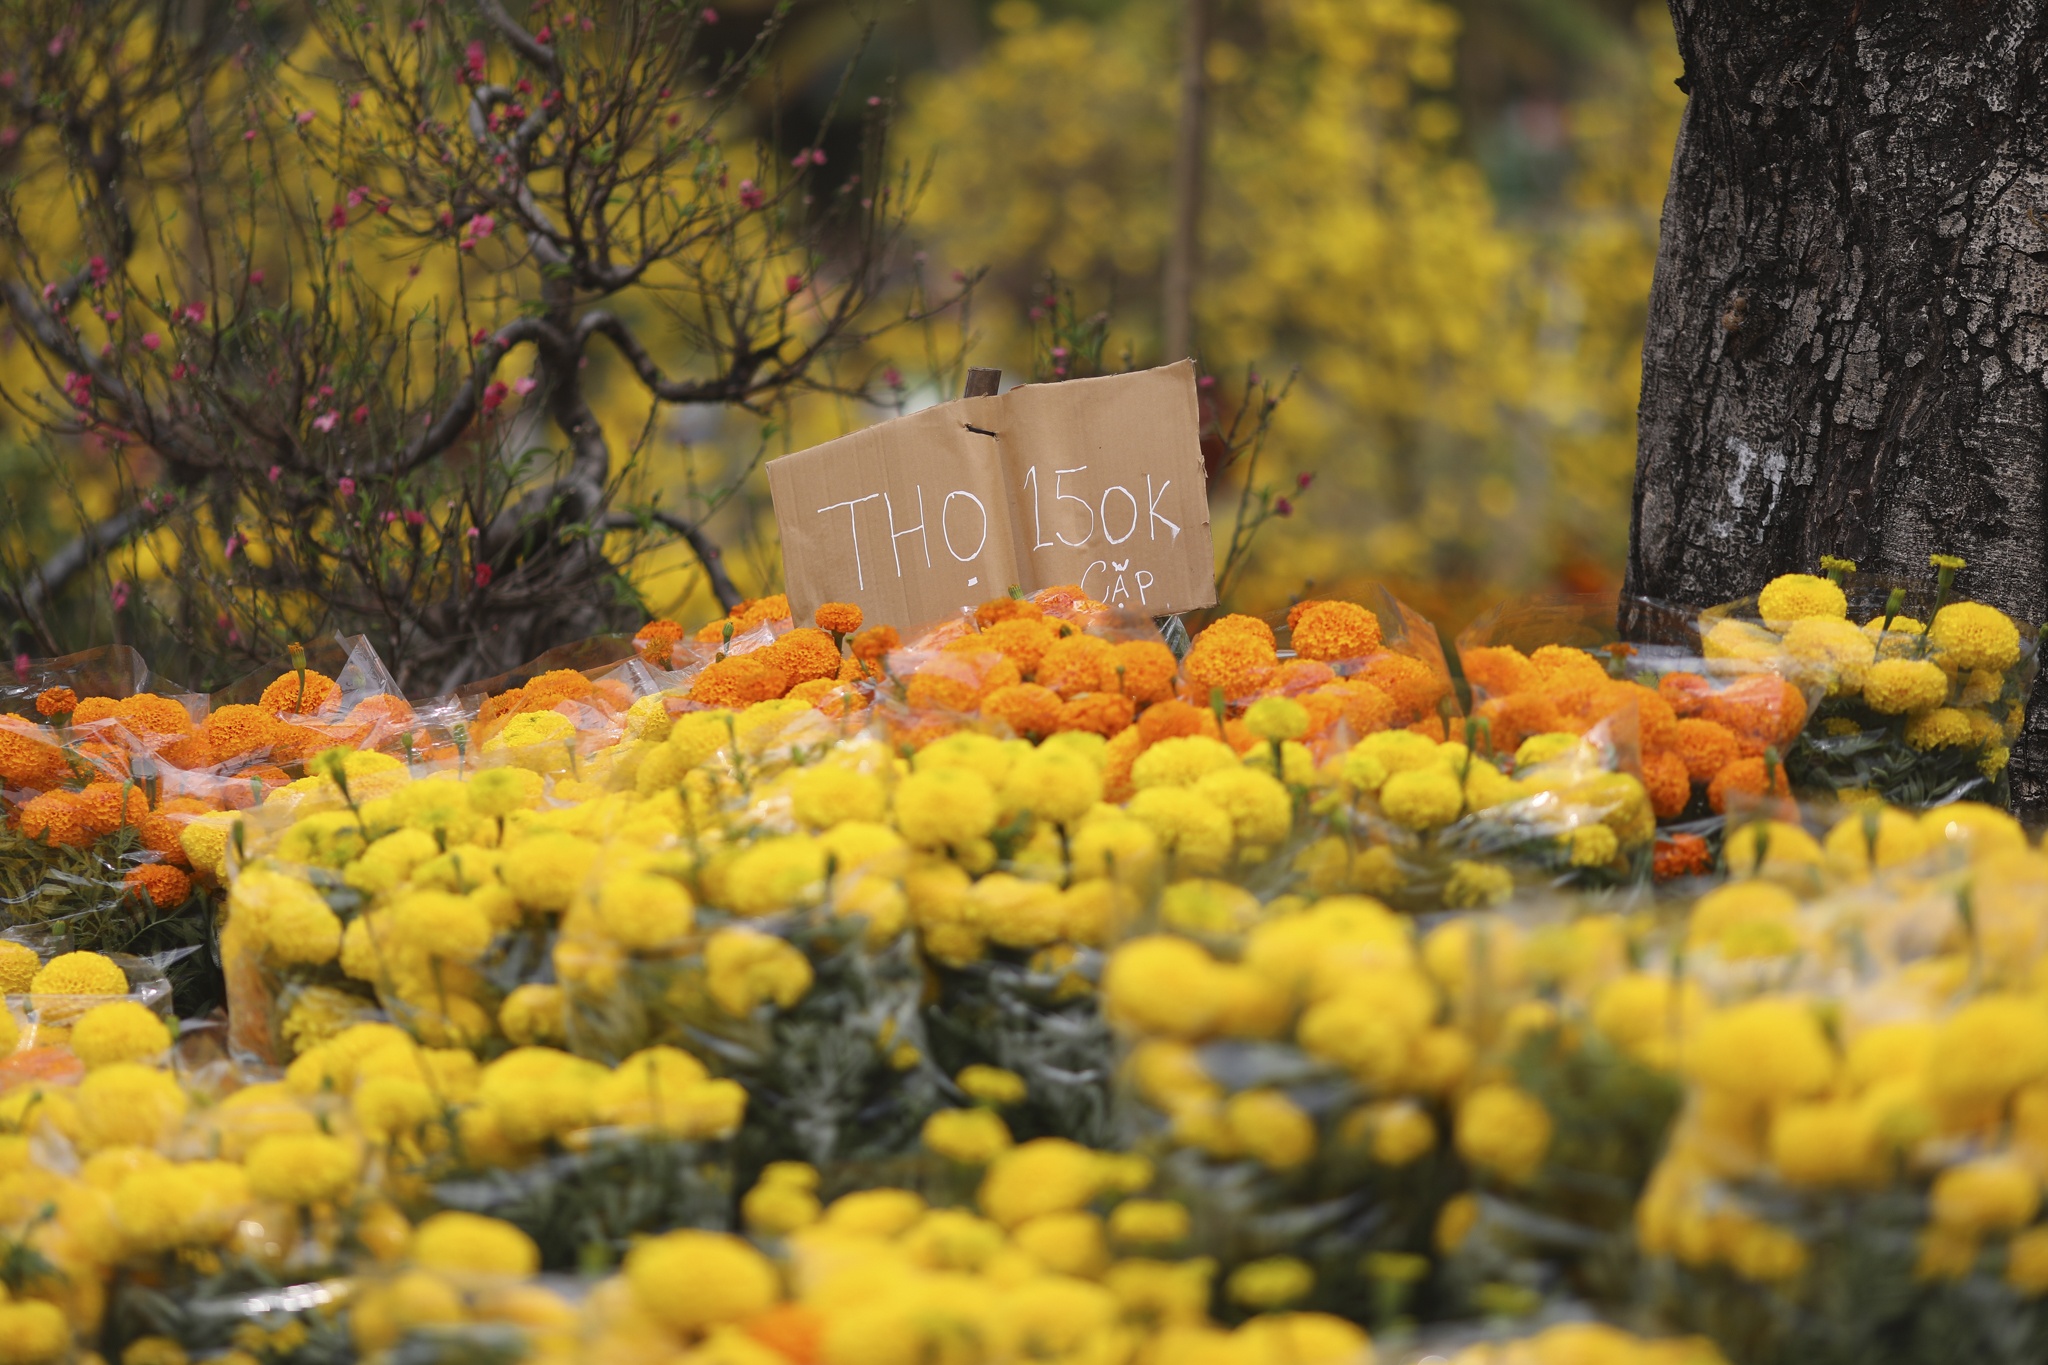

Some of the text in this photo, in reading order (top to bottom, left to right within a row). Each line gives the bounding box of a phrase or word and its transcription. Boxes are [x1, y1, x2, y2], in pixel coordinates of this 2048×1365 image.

[817, 465, 1181, 590] THỌ 150K
[1080, 558, 1154, 609] CẶP
